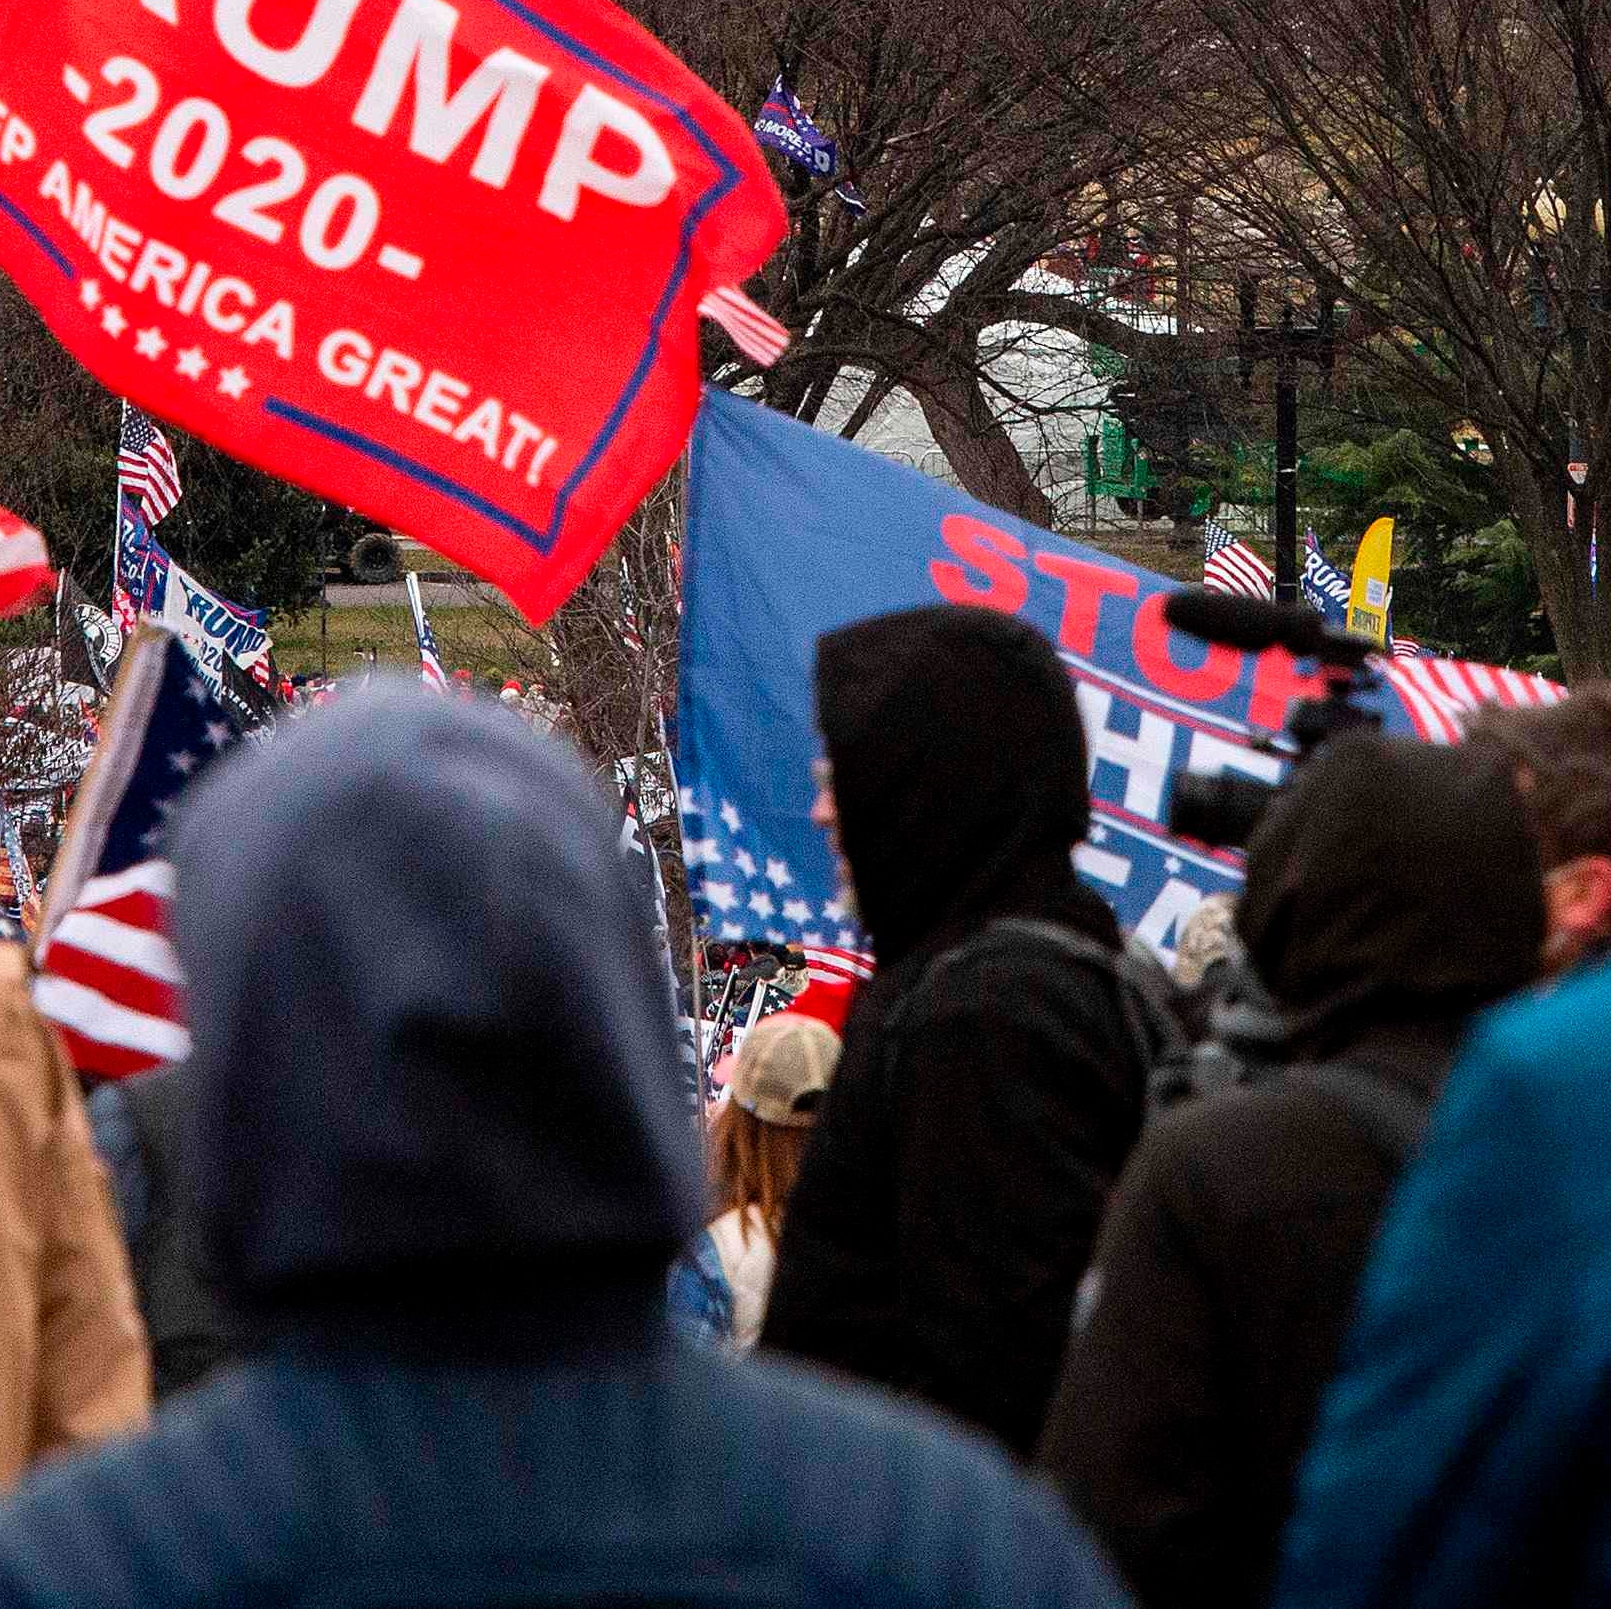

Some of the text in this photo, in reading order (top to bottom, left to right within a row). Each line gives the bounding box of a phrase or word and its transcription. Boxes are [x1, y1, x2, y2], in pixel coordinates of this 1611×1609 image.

[63, 55, 425, 280] -2020-
[39, 160, 294, 353] AMERICA
[318, 329, 558, 484] GREAT!
[179, 575, 266, 658] TRUMP
